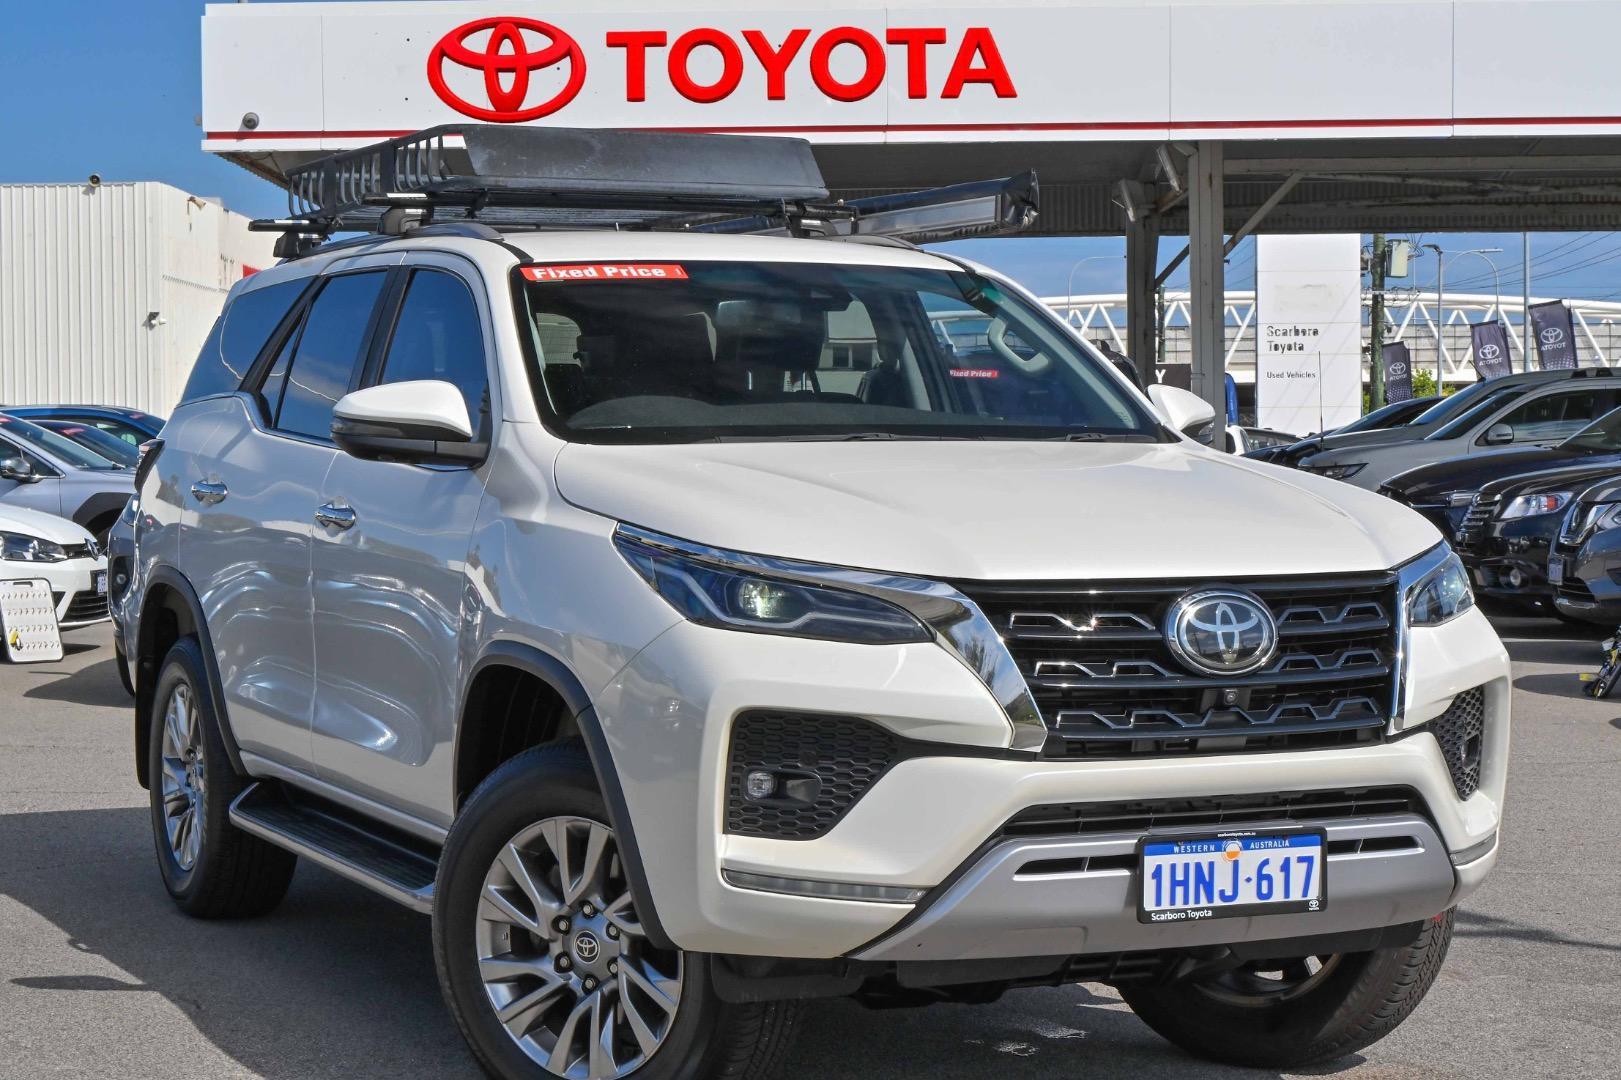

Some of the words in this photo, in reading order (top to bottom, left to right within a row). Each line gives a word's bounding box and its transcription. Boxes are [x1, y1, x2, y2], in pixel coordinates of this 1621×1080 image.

[606, 26, 1018, 104] TOYOTA
[532, 267, 599, 279] Fixed
[602, 265, 667, 277] Price
[1266, 325, 1320, 337] Scarboro
[1266, 340, 1305, 354] Toyota
[1266, 371, 1285, 379] Used
[1286, 371, 1316, 379] Vehicles
[1173, 844, 1216, 854] WESTERN
[1250, 839, 1290, 850] AUSTRALIA
[1151, 911, 1186, 921] Scarboro
[1186, 909, 1213, 920] Toyota
